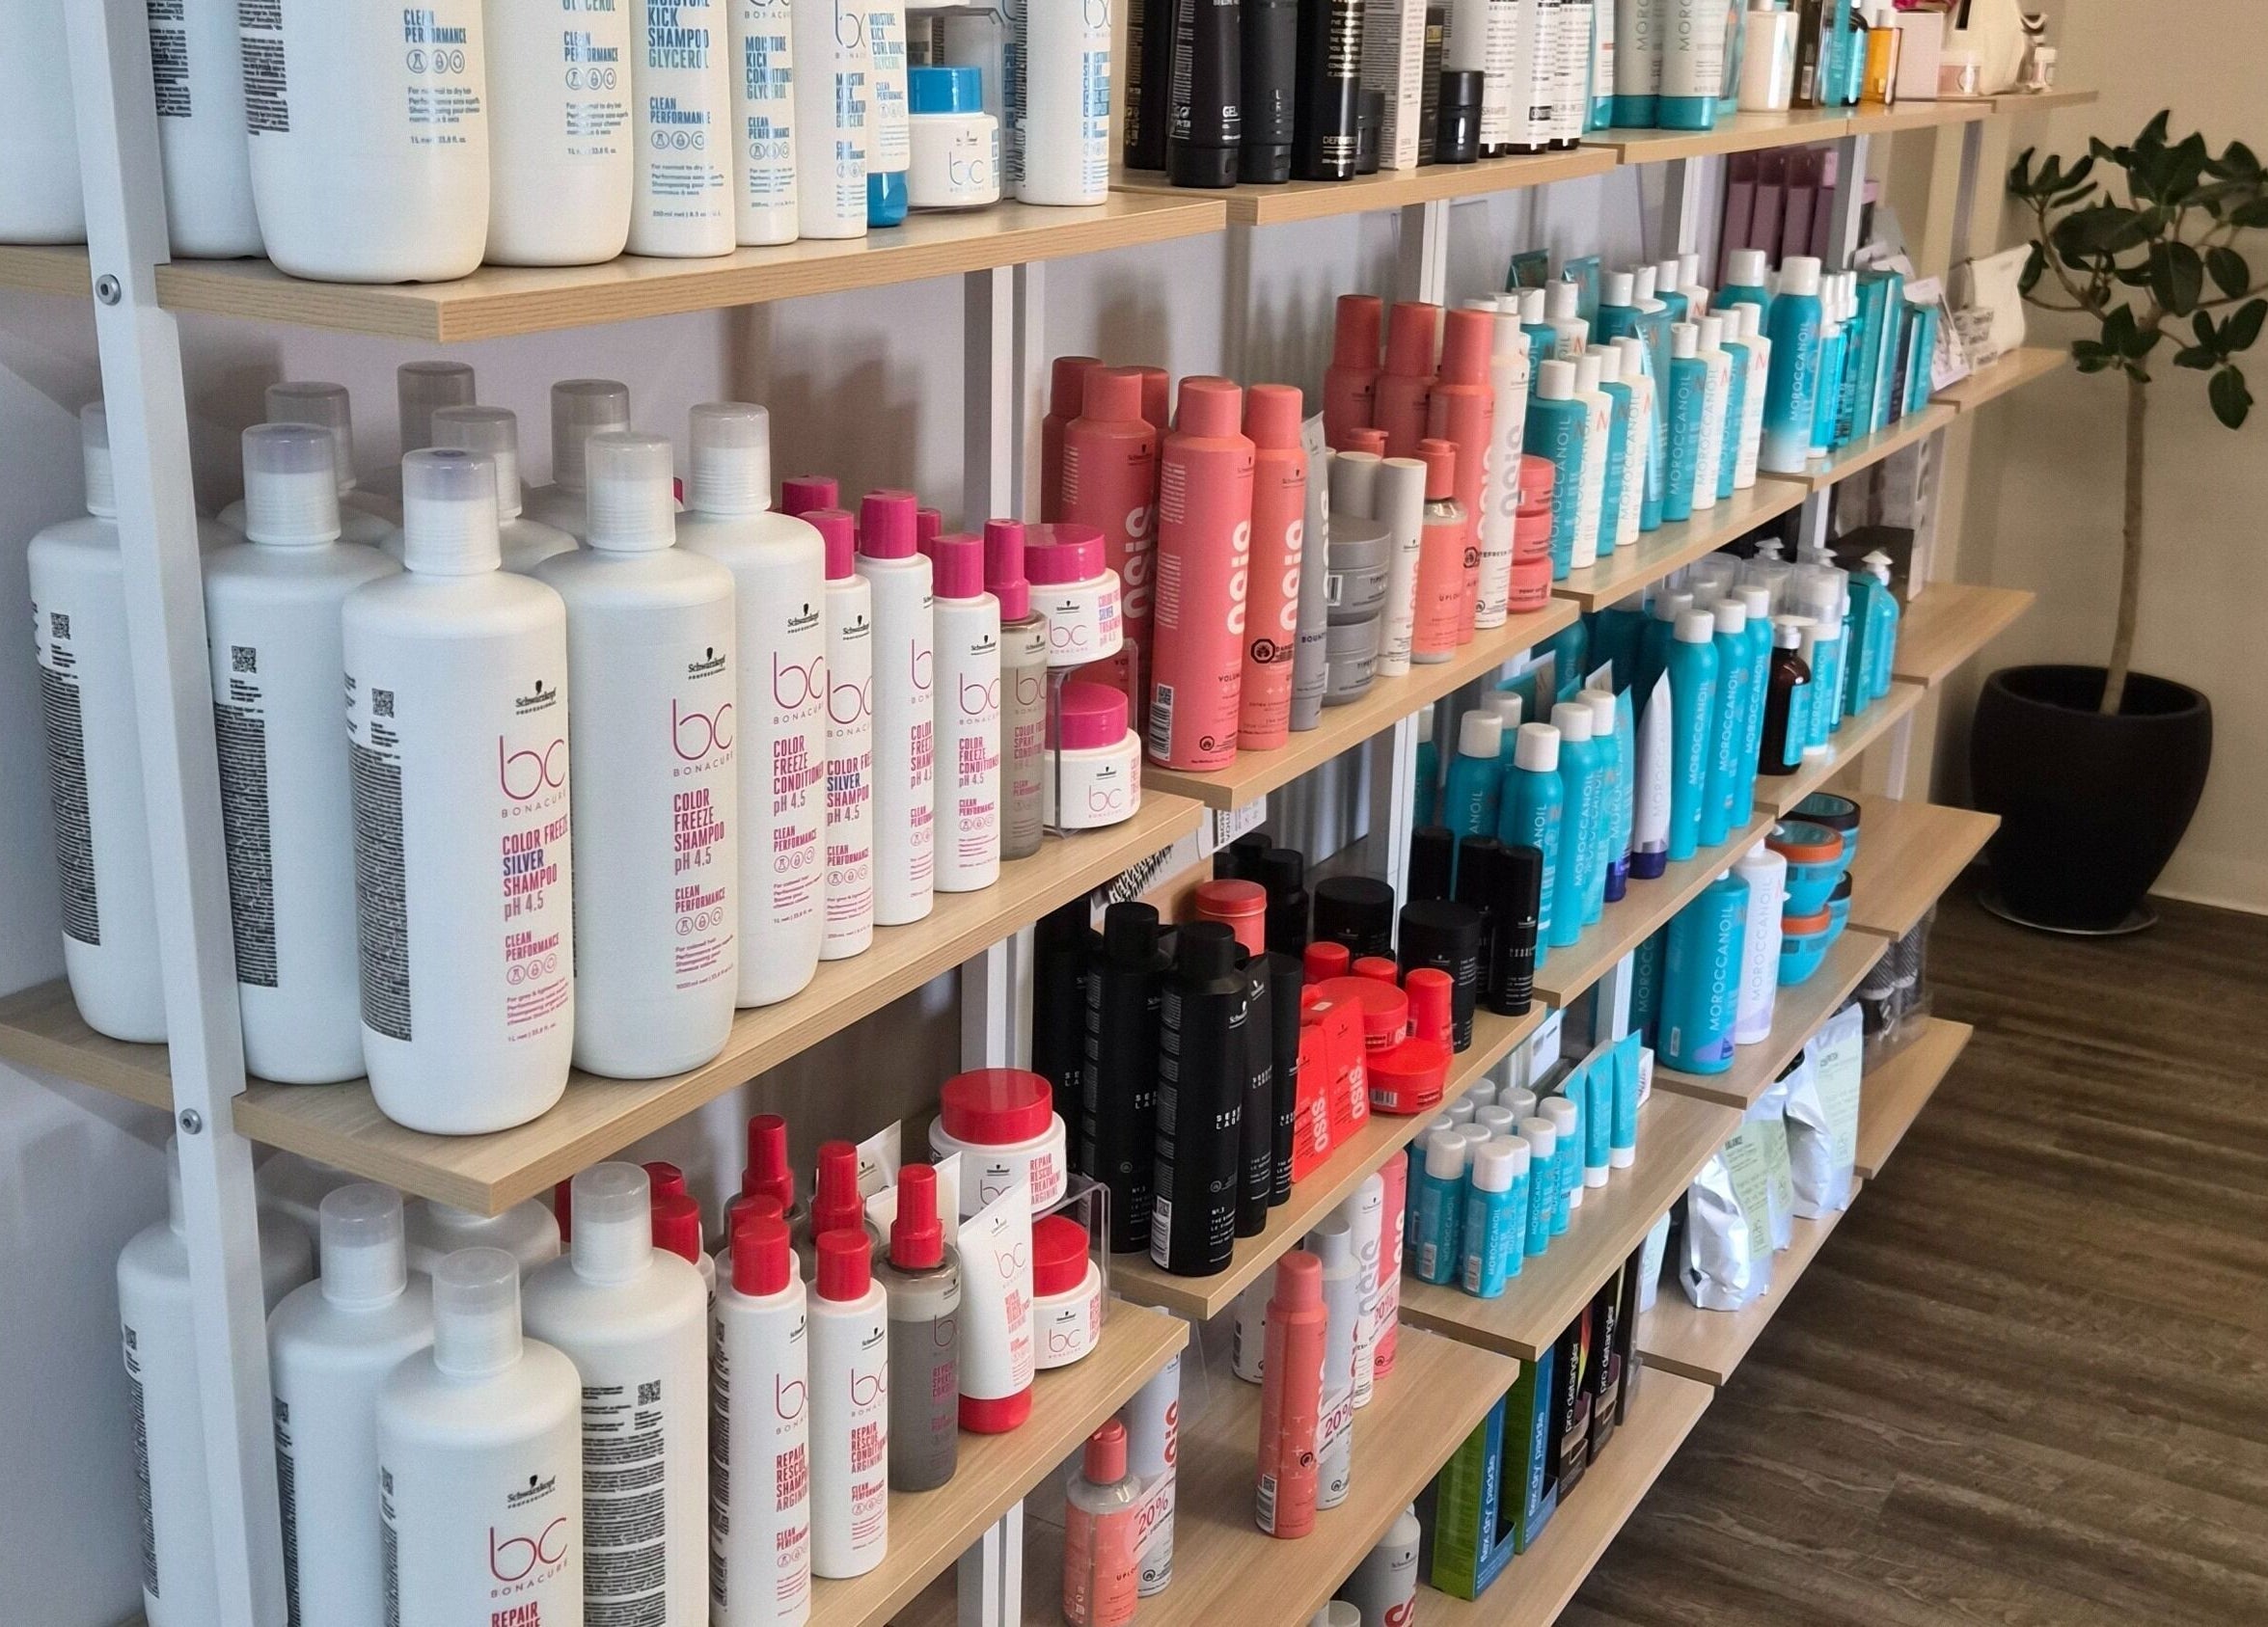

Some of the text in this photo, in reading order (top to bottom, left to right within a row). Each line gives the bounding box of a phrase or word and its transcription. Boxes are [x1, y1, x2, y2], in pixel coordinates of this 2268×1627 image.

[648, 8, 678, 27] KICK
[405, 27, 467, 44] PERORMANCE
[648, 28, 709, 48] SHAMPOO
[650, 97, 676, 111] CLEAN
[1670, 374, 1691, 495] MOROCCANOIL
[1548, 416, 1571, 554] MOROCCANOIL
[1050, 618, 1088, 649] bc
[774, 651, 824, 709] bc
[672, 698, 733, 761] bc
[774, 735, 805, 759] COLOR
[959, 736, 984, 750] COLOR
[498, 734, 566, 801] bc
[774, 752, 808, 776] FREEZE
[827, 758, 859, 776] COLOR
[827, 773, 861, 793] SILVER
[674, 788, 710, 814] COLOR
[774, 790, 806, 818] pH 4.5
[674, 806, 715, 833] FREEZE
[828, 803, 861, 827] pH 4.5
[503, 830, 541, 856] COLOR
[674, 821, 725, 853] SHAMPOO
[774, 826, 796, 841] CLEAN
[1575, 774, 1595, 886] MOROCCANOIL
[503, 848, 544, 877] SILVER
[675, 846, 712, 876] pH 4.5
[827, 844, 849, 857] CLEAN
[504, 862, 558, 898] SHAMPOO
[675, 884, 700, 901] CLEAN
[505, 889, 544, 922] pH 4.5
[675, 886, 725, 914] PERFORMANCE
[506, 930, 533, 949] CLEAN
[506, 932, 560, 963] PERFORMANCE
[1708, 903, 1735, 1032] MOROCCANOIL
[1030, 1152, 1052, 1171] REPAIR
[1049, 1328, 1080, 1353] bc
[1600, 1369, 1609, 1395] pro
[851, 1422, 877, 1440] REPAIR
[1565, 1407, 1574, 1433] pro
[777, 1442, 806, 1469] REPAIR
[851, 1433, 879, 1452] RESCUE
[1137, 1489, 1168, 1536] 20%
[777, 1527, 796, 1544] CLEAN
[489, 1516, 567, 1583] bc
[491, 1601, 539, 1627] REPAIR
